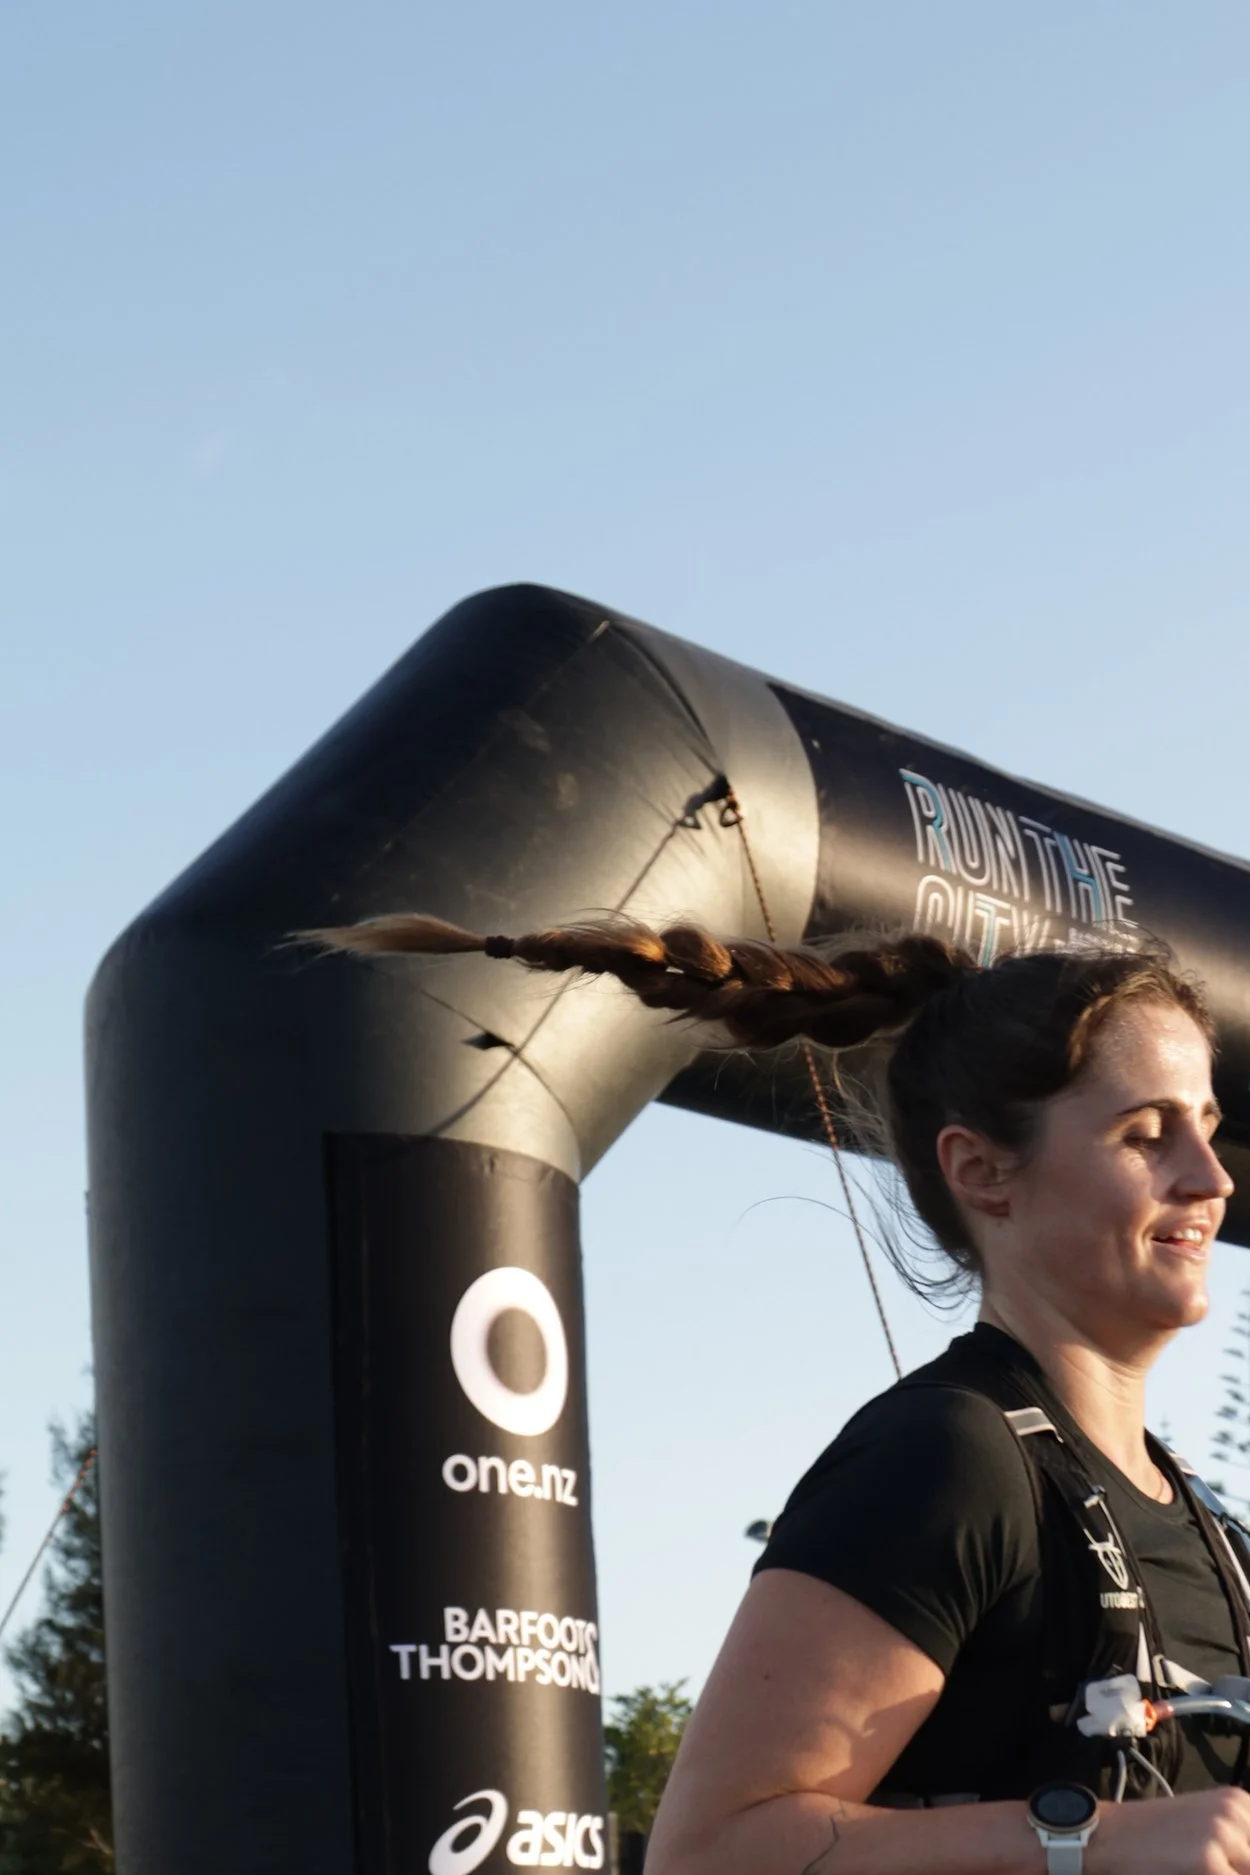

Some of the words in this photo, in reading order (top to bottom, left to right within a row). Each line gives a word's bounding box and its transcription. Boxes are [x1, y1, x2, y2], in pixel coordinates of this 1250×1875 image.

[899, 767, 1030, 902] RUN
[441, 1453, 578, 1507] one.nz
[389, 1643, 589, 1691] THOMPSON
[506, 1809, 604, 1869] asics
